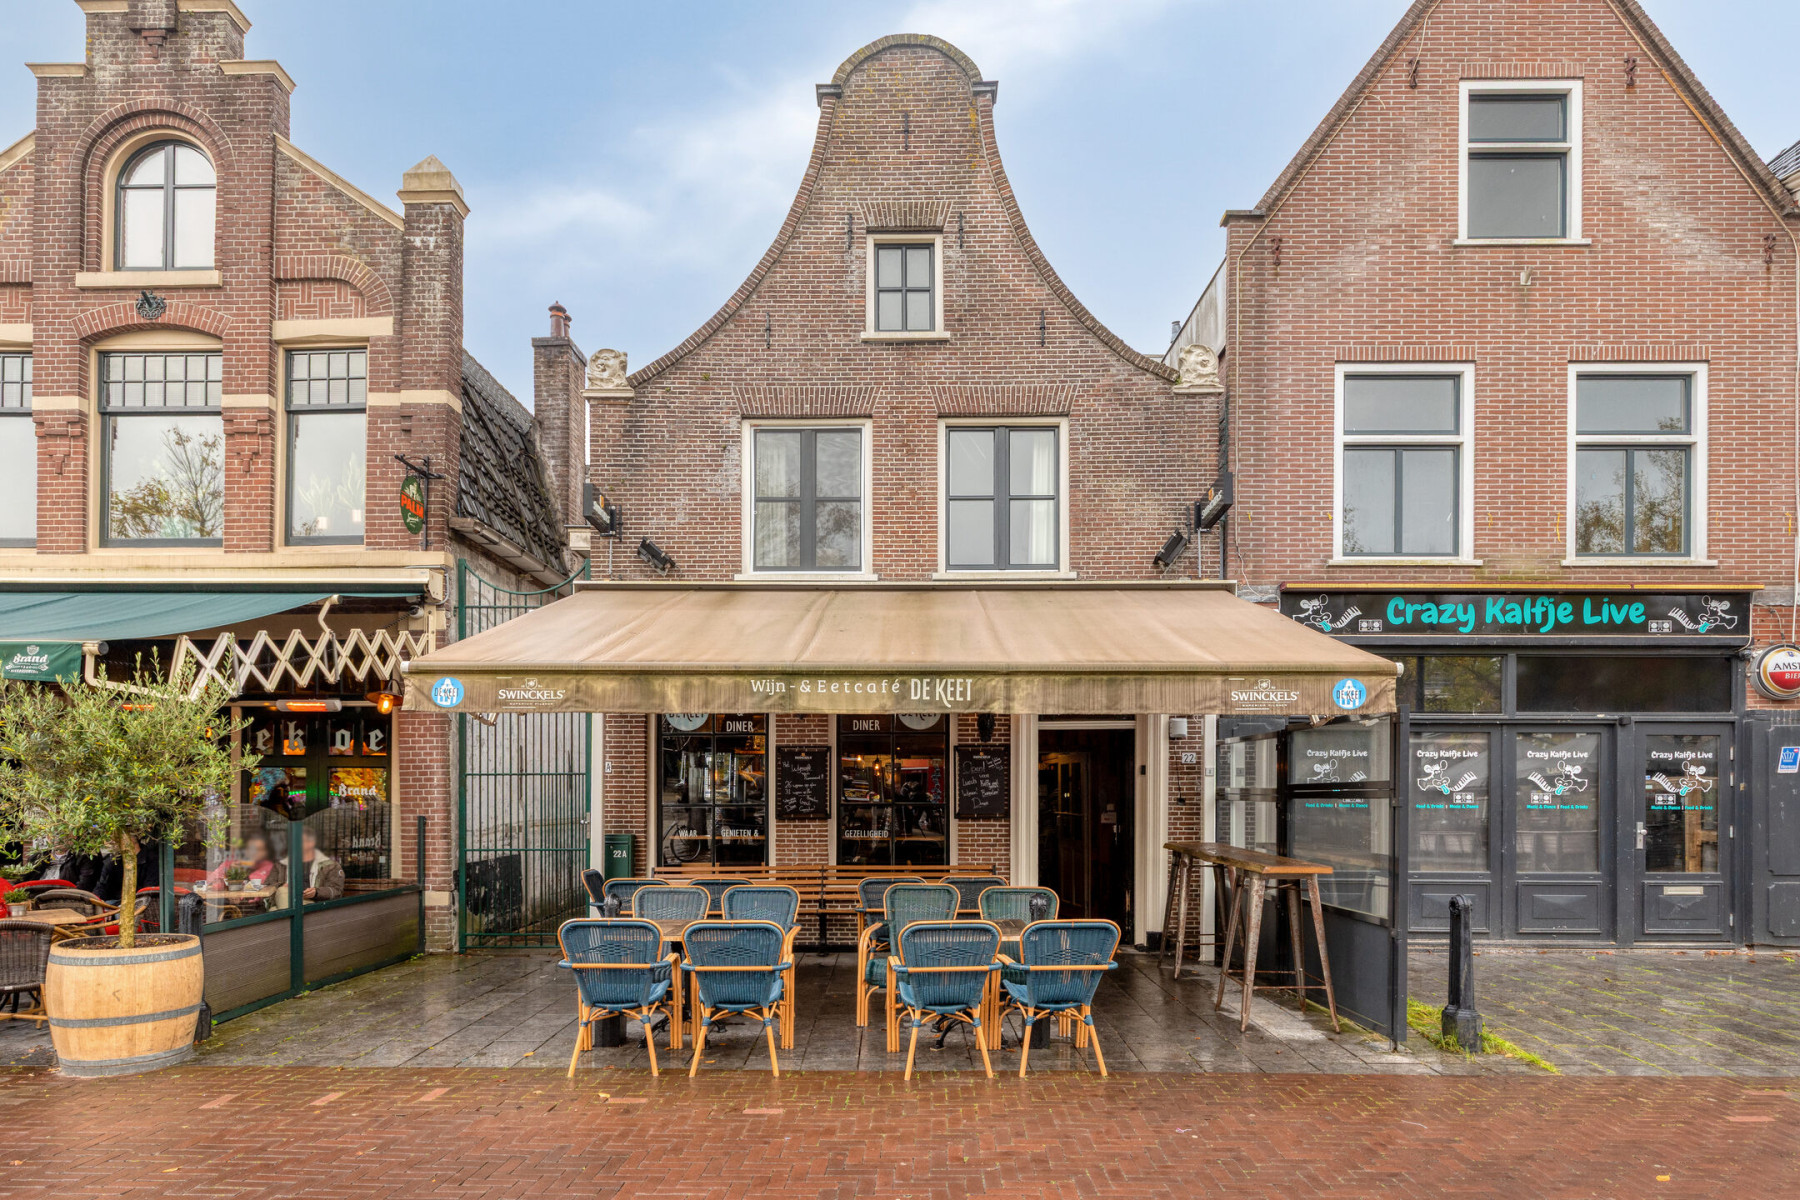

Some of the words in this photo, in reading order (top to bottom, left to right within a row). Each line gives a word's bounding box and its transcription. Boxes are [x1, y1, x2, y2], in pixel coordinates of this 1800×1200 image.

[1387, 596, 1475, 633] Crazy
[1485, 596, 1574, 633] Kalfje
[1583, 597, 1646, 625] Live
[13, 653, 49, 664] Brand
[817, 679, 900, 693] Eetcafé
[911, 678, 930, 700] DE
[935, 678, 973, 708] KEET
[726, 720, 754, 732] DINER
[853, 719, 880, 731] DINER
[1184, 753, 1195, 763] 22
[1306, 749, 1328, 758] Crazy
[1329, 749, 1351, 758] Kalfje
[1352, 749, 1368, 757] Live
[1416, 749, 1438, 759] Crazy
[1439, 749, 1461, 759] Kalfje
[1526, 750, 1548, 760] Crazy
[1550, 750, 1572, 760] Kalfje
[1573, 750, 1589, 758] Live
[1651, 750, 1673, 760] Crazy
[1674, 750, 1696, 760] Kalfje
[338, 782, 377, 798] Brand
[678, 829, 698, 838] WAAR
[720, 828, 752, 838] GENIETEN
[753, 829, 759, 837] &
[844, 829, 889, 838] GEZELLIGHEID
